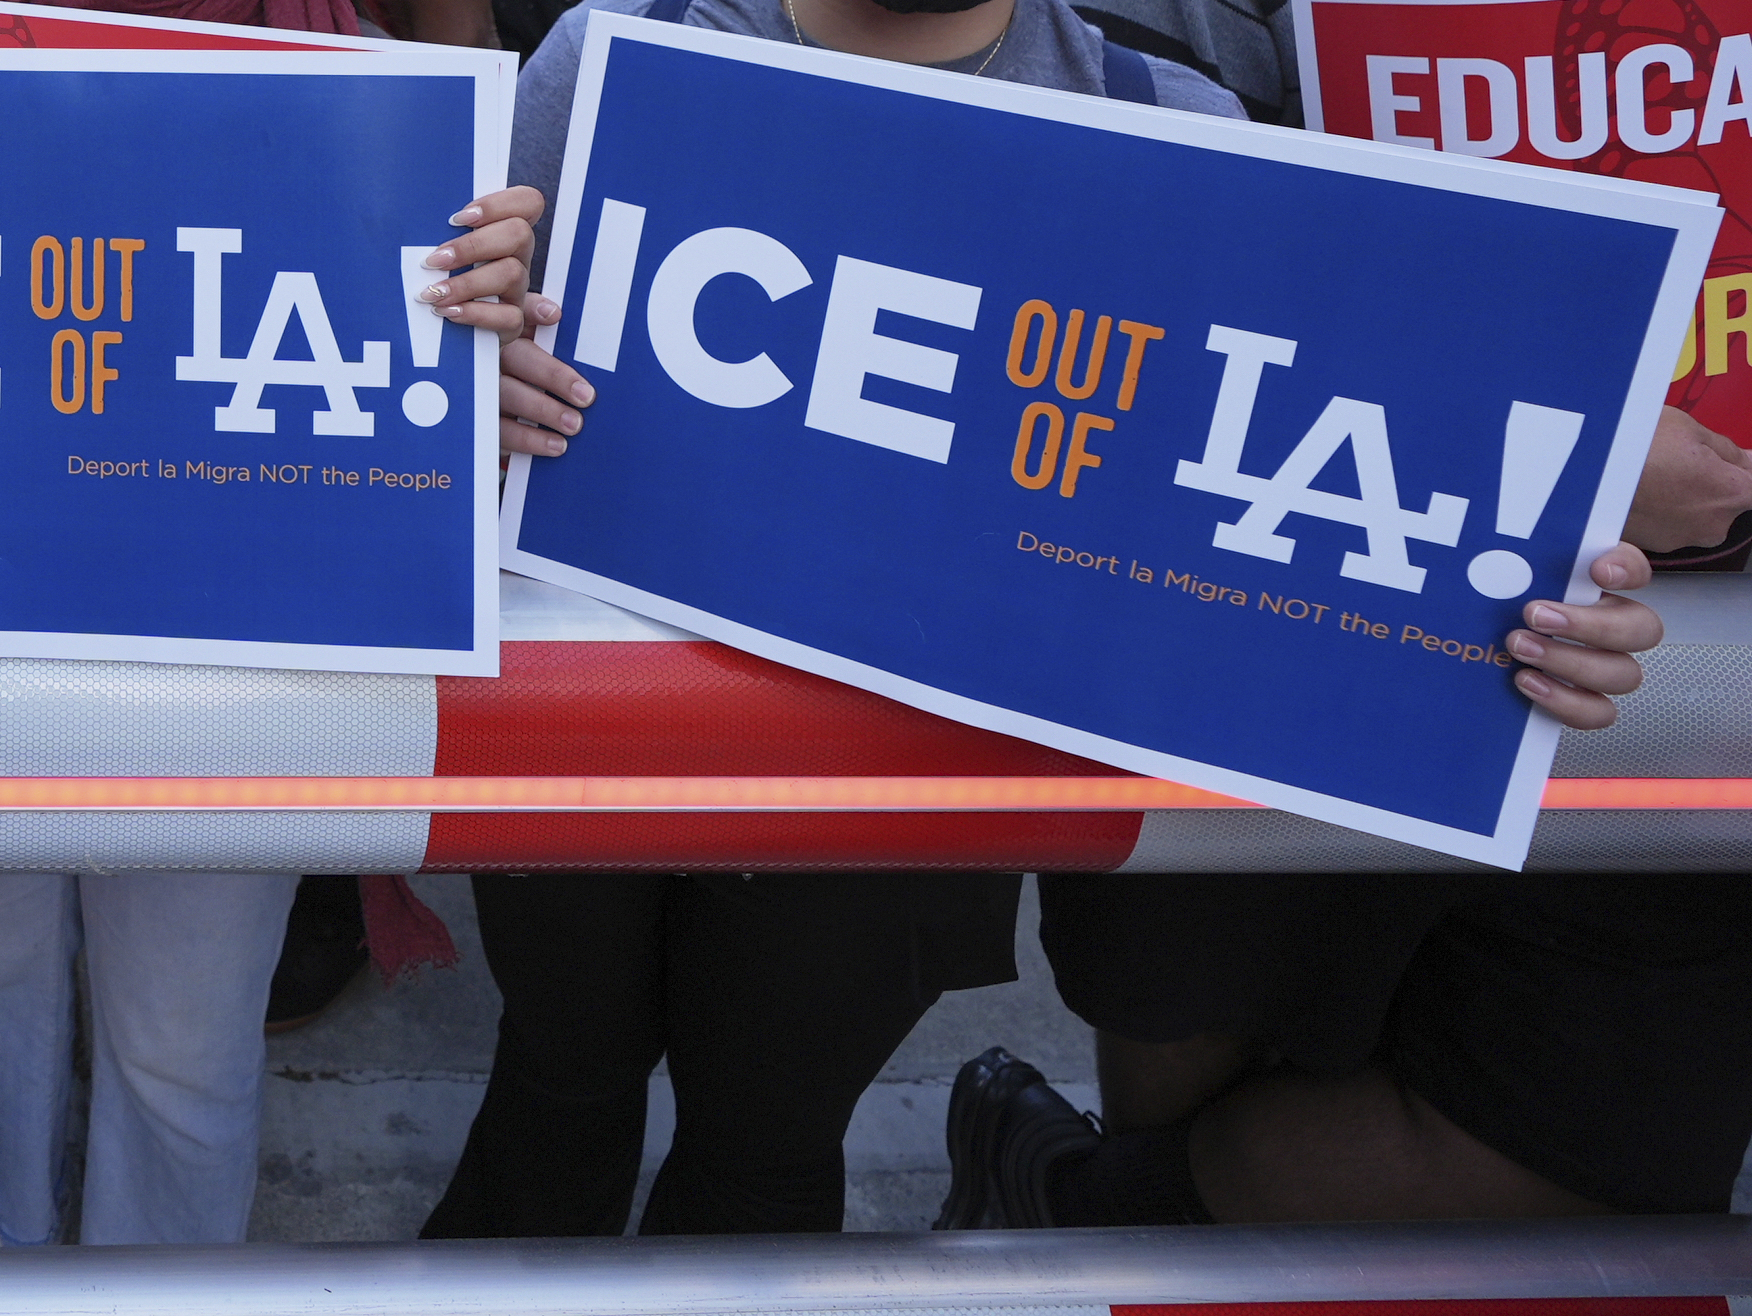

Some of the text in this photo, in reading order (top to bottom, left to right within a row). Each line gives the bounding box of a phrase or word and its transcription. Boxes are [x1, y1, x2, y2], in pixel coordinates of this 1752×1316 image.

[29, 235, 146, 323] OUT
[174, 226, 452, 437] LA!
[49, 328, 124, 415] OF
[573, 197, 1586, 601] ICE OUT OF LA!
[67, 455, 452, 492] Deport la Migra NOT the People
[1015, 530, 1512, 669] Deport la Migra NOT the People
